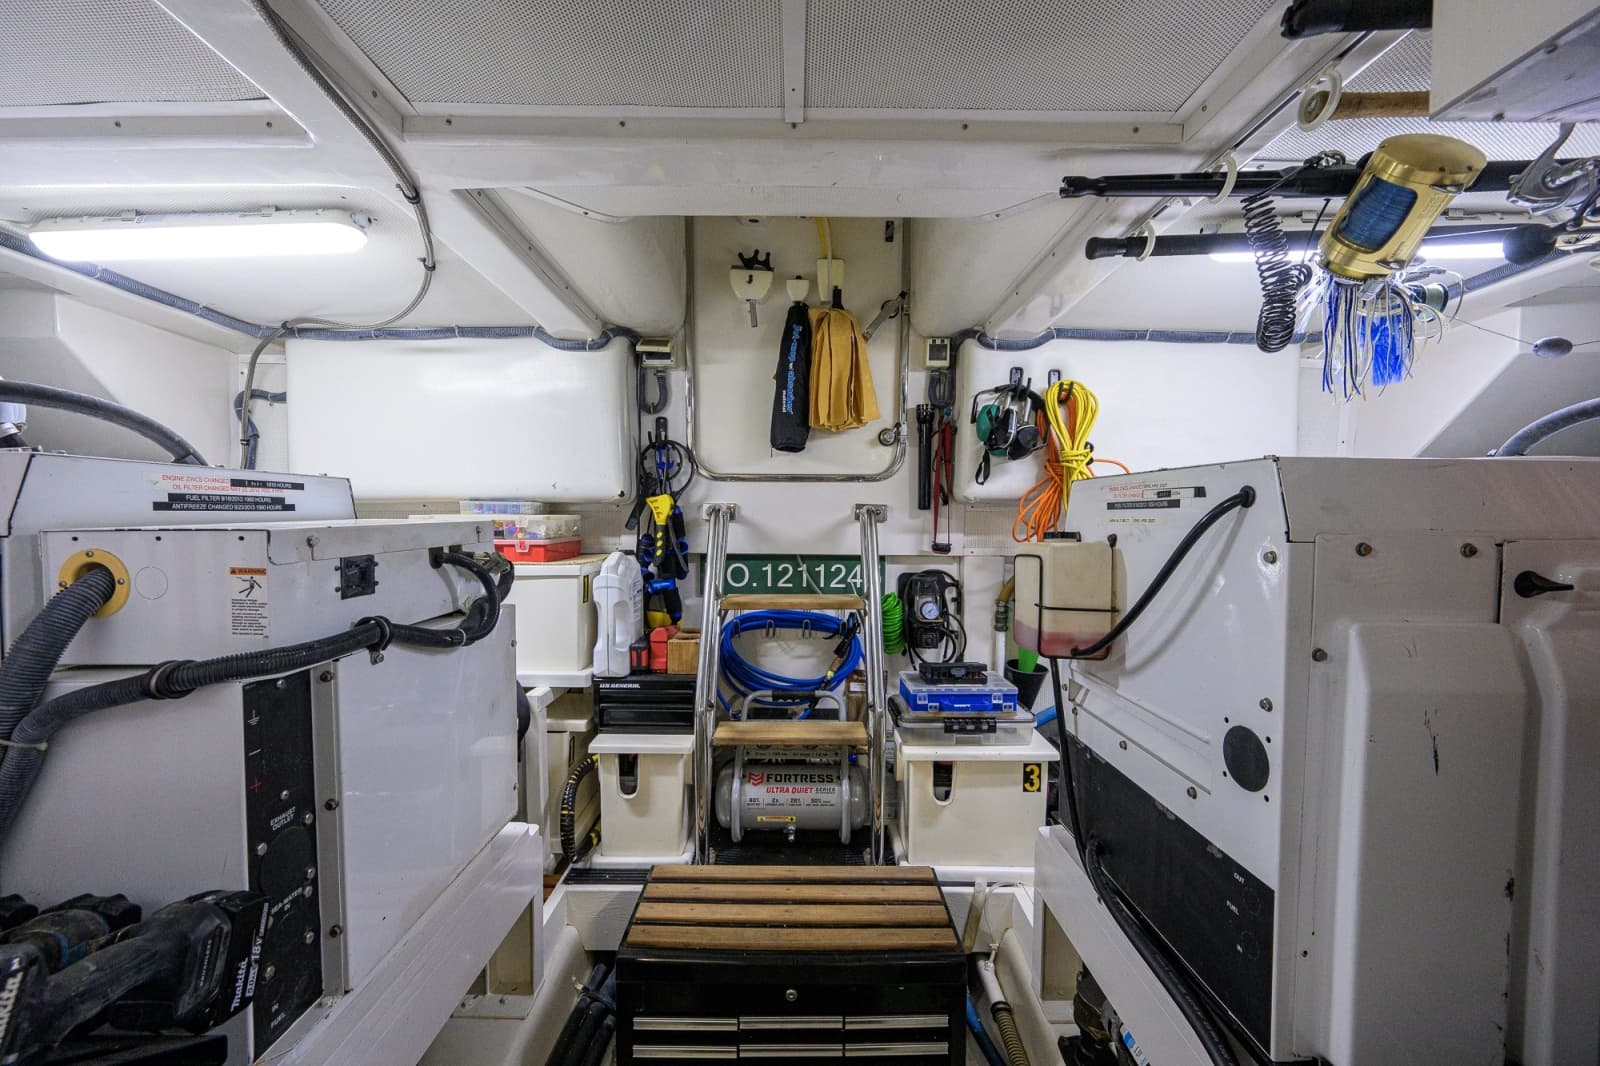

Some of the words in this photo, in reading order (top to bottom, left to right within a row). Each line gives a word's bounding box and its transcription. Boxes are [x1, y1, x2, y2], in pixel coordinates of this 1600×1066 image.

[162, 474, 185, 482] ENGINE
[726, 563, 882, 588] O.121124
[766, 773, 834, 784] FORTRESS
[1024, 764, 1040, 792] 3
[766, 786, 790, 794] ULTRA
[791, 786, 814, 794] QUIET
[270, 806, 296, 826] EXHAUST
[272, 814, 294, 831] OUTLET
[1233, 872, 1245, 884] OUT
[1226, 900, 1240, 916] FUEL
[230, 957, 249, 1013] makita
[0, 971, 24, 1043] akita
[270, 1012, 287, 1029] FUEL
